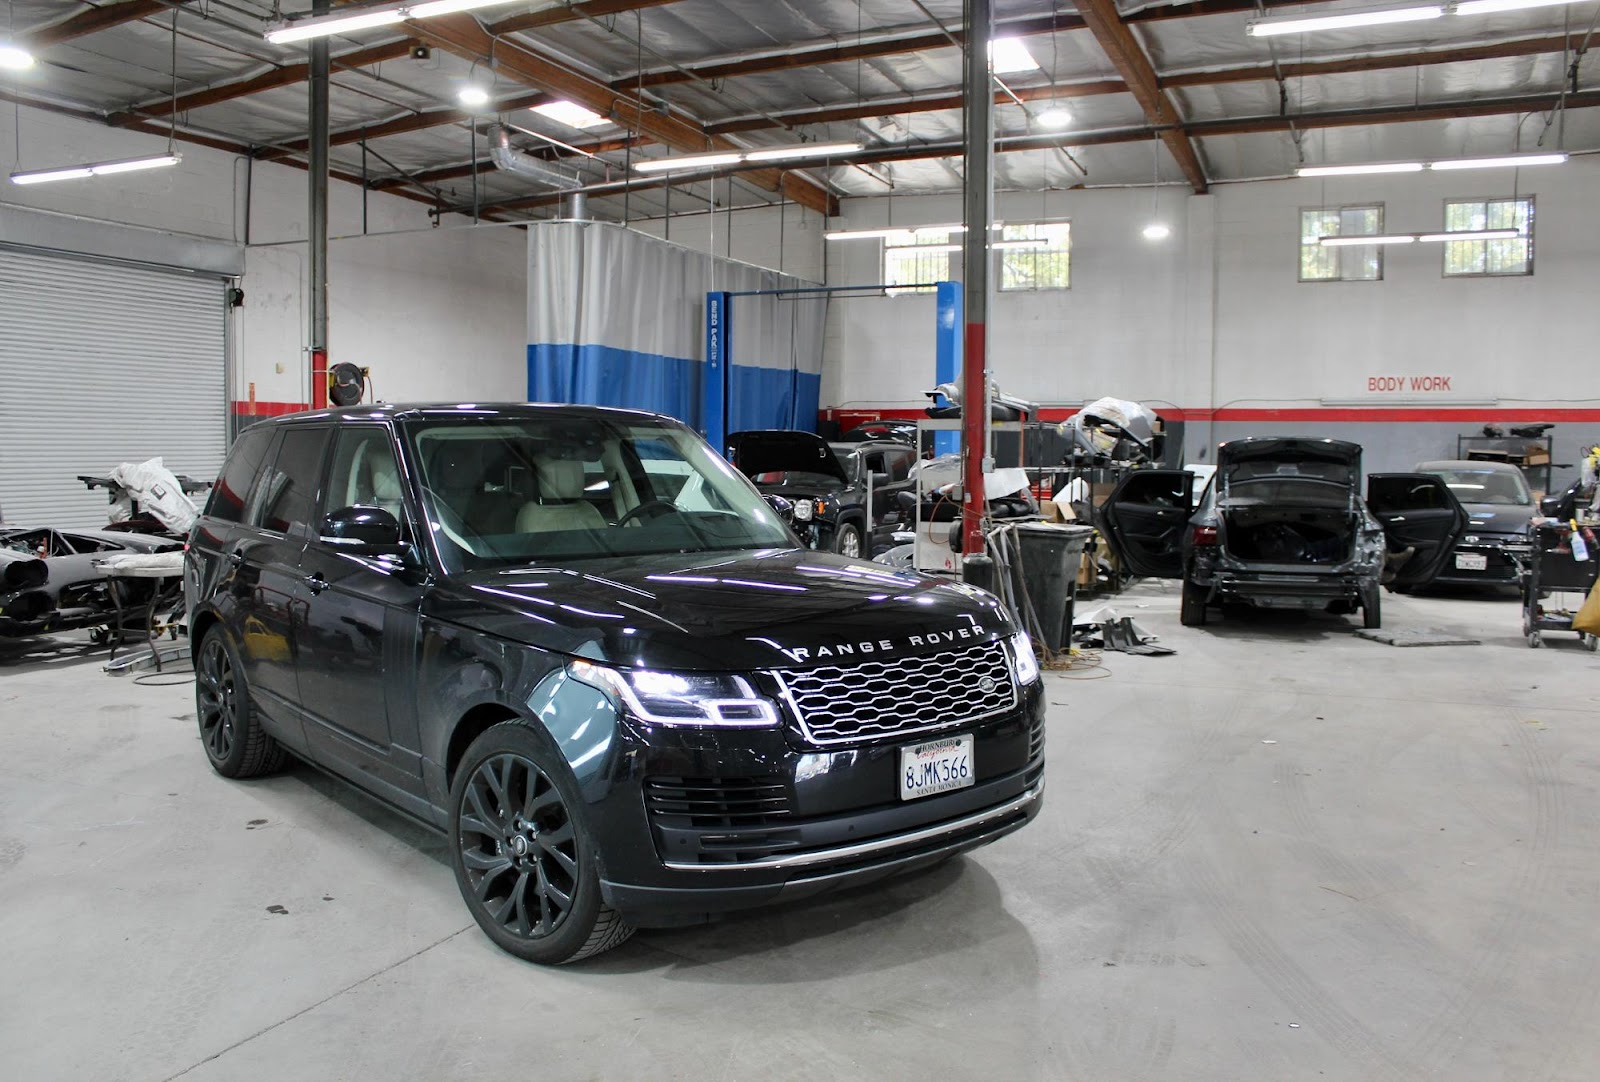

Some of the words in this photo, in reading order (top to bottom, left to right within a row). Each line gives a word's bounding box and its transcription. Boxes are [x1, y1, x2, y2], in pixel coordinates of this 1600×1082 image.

[1368, 377, 1405, 391] BODY
[1410, 376, 1451, 391] WORK
[793, 639, 894, 658] RANGE
[909, 624, 985, 647] ROVER
[906, 755, 967, 789] 8JMK566
[916, 785, 936, 796] SANTA
